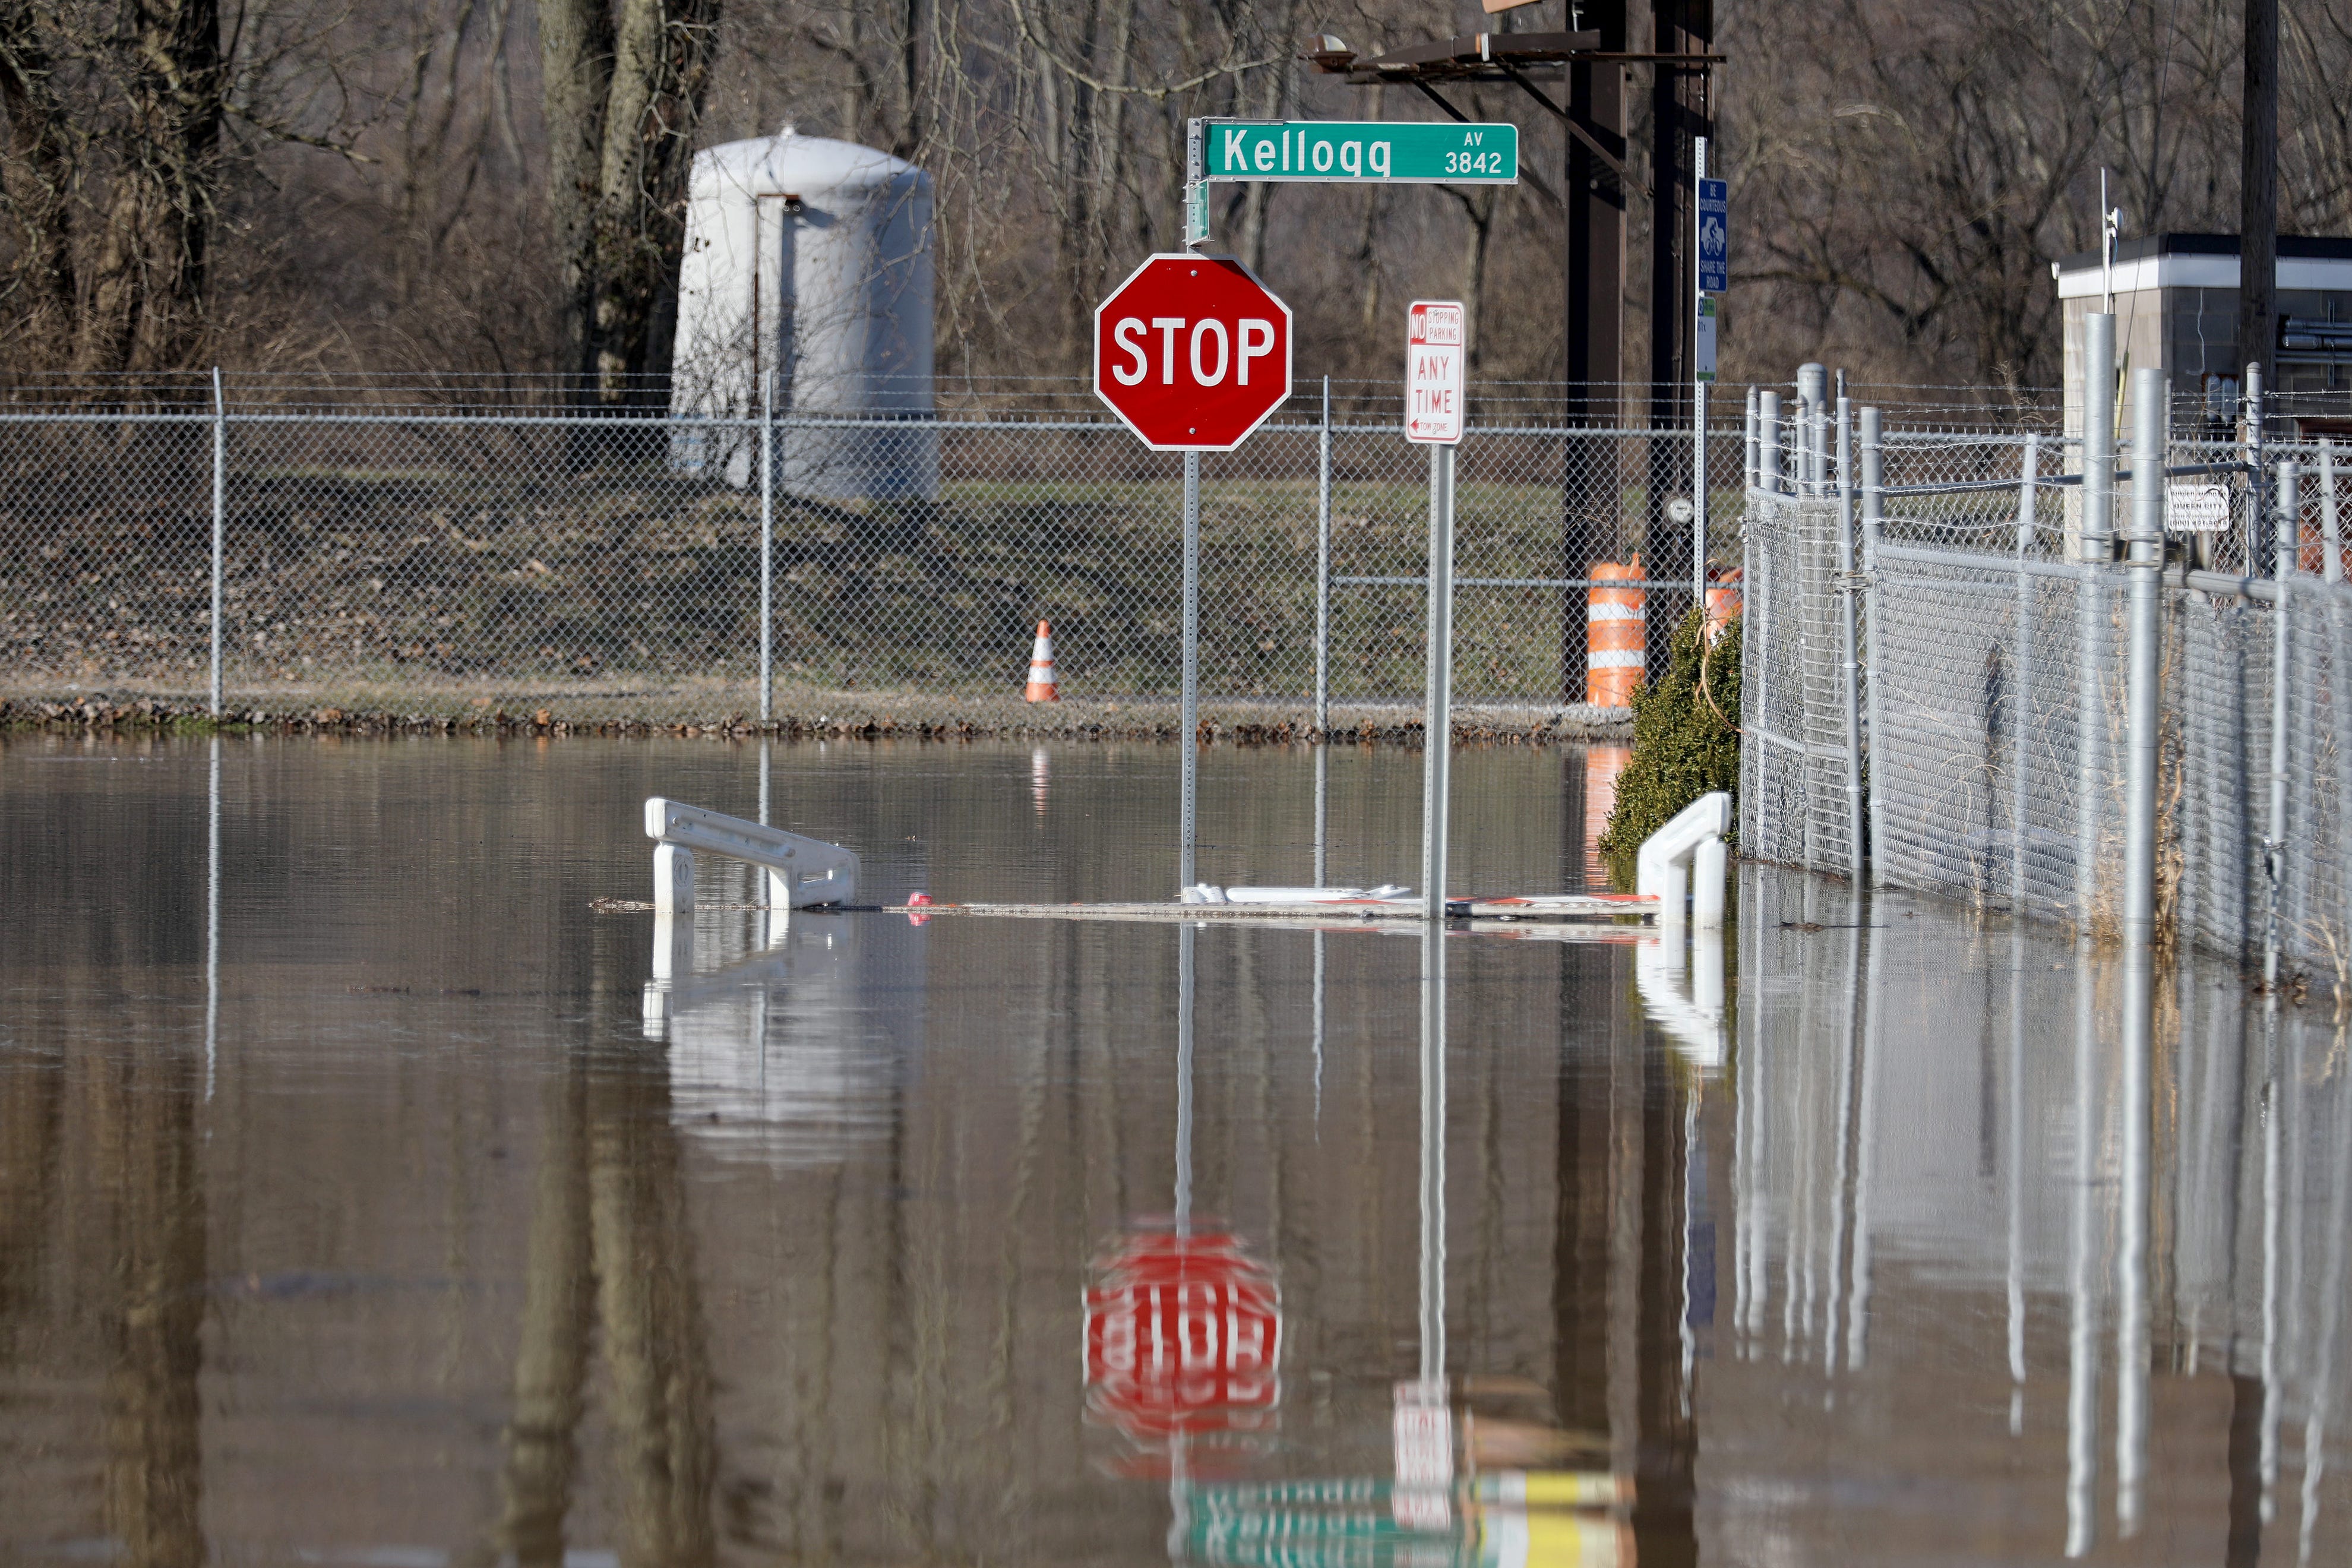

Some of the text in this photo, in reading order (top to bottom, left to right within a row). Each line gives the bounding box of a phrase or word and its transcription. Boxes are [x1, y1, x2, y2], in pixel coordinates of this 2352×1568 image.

[1463, 132, 1483, 146] AV
[1224, 129, 1392, 178] Kellogg
[1444, 153, 1502, 174] 3842
[1700, 198, 1727, 213] COURTEOUS
[1700, 260, 1726, 275] SHARE THE
[1706, 276, 1719, 289] ROAD
[1428, 311, 1459, 325] STOPPING
[1411, 313, 1425, 339] NO
[1429, 327, 1457, 340] PARKING
[1112, 317, 1276, 387] STOP
[1417, 356, 1450, 381] ANY
[1416, 389, 1453, 414] TIME
[1420, 422, 1431, 431] TOW
